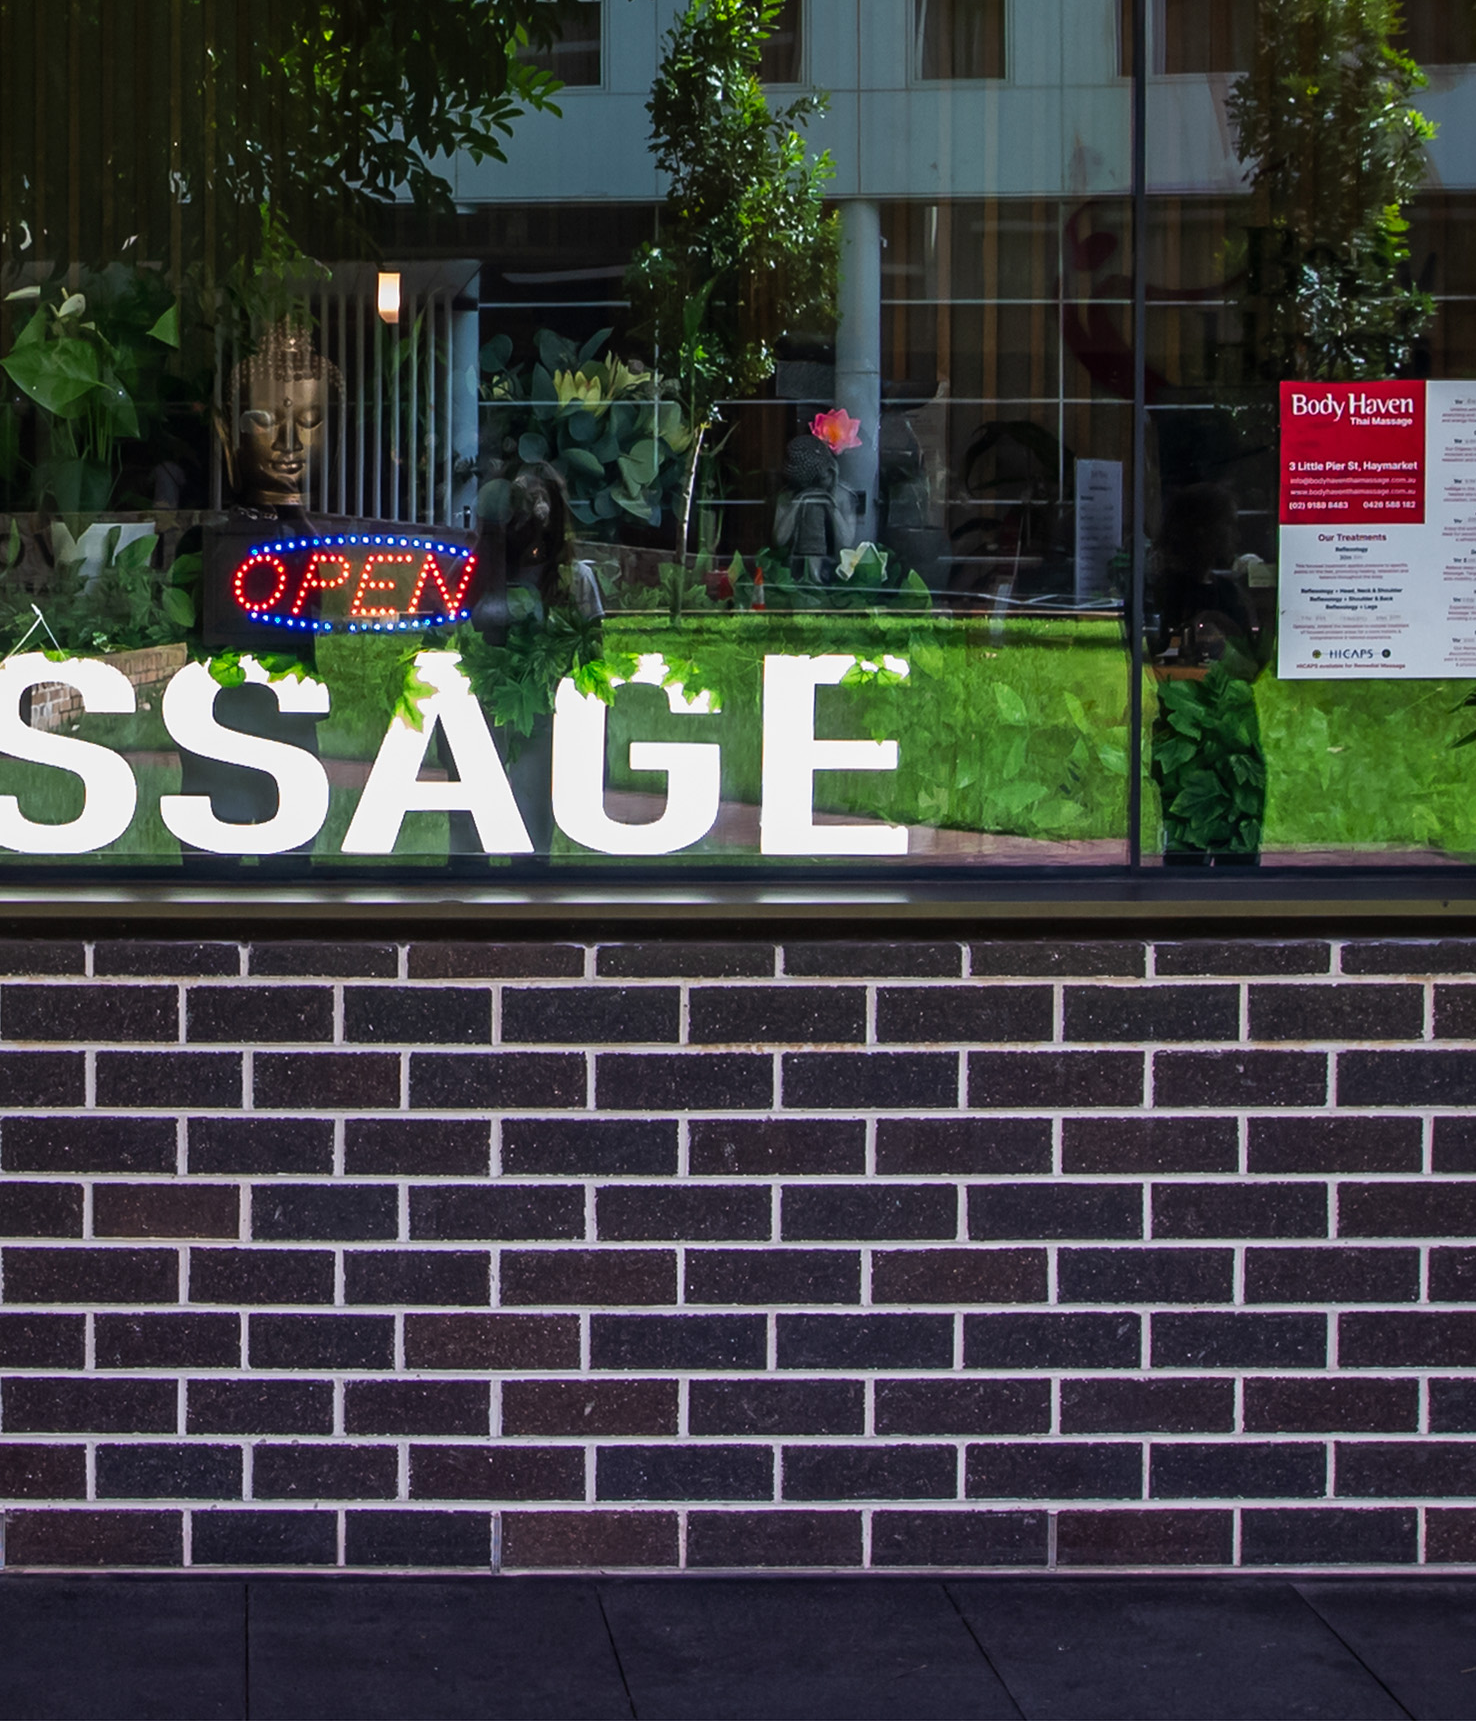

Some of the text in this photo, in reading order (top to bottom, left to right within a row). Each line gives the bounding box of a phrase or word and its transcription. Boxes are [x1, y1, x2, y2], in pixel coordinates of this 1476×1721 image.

[1292, 393, 1414, 422] Body Haven
[1350, 417, 1413, 427] Thai Massage
[1289, 461, 1417, 472] 3 Little Pier St, Haymarket
[232, 552, 479, 616] OPEN
[1330, 649, 1373, 659] HICAPS
